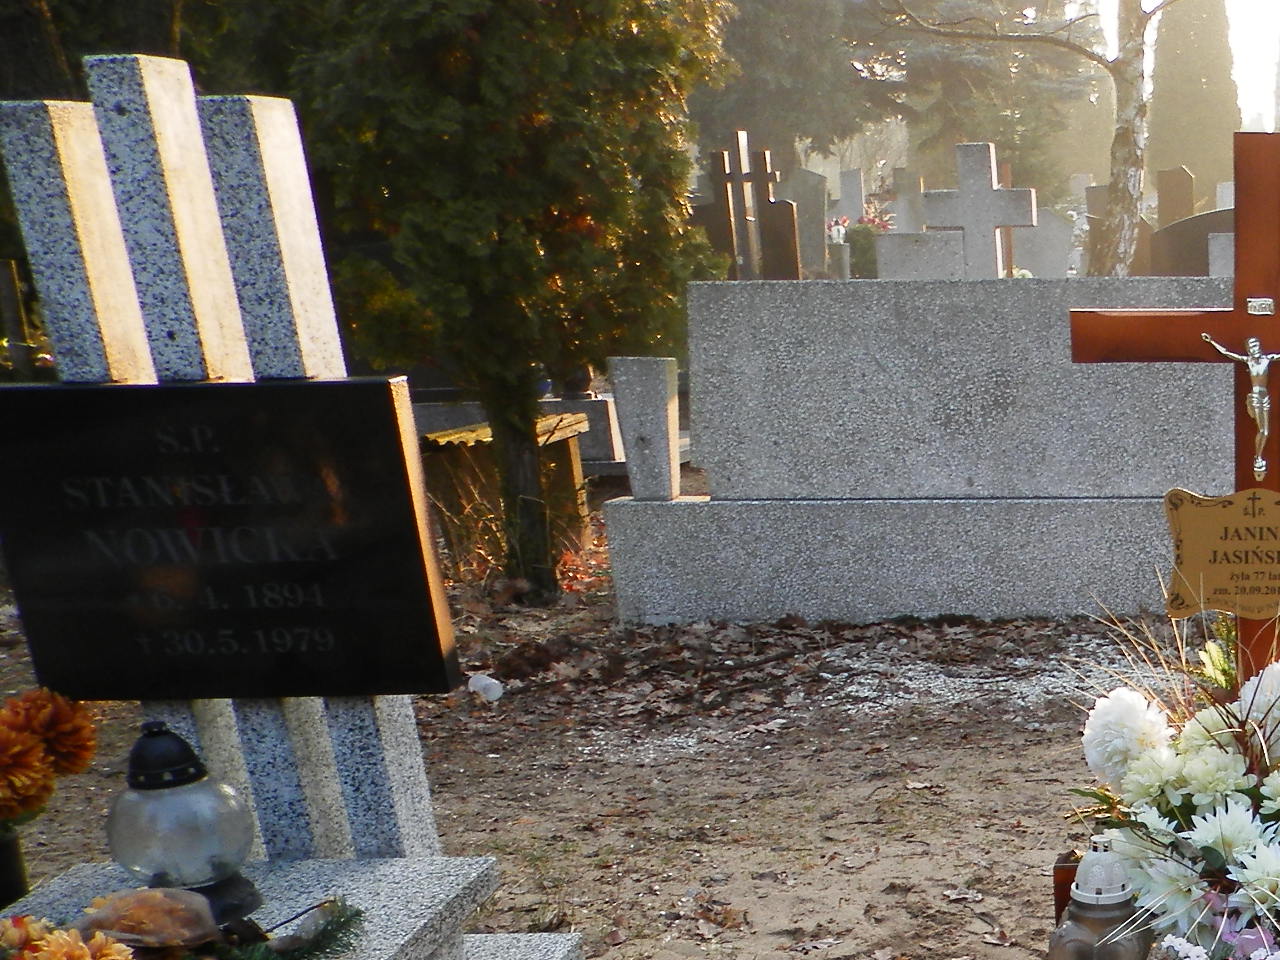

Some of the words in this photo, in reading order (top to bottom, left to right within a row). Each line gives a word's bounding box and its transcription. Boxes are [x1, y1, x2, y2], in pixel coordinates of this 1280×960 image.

[81, 526, 340, 565] NOWICKA
[1254, 571, 1265, 581] 77
[242, 582, 328, 610] 1894
